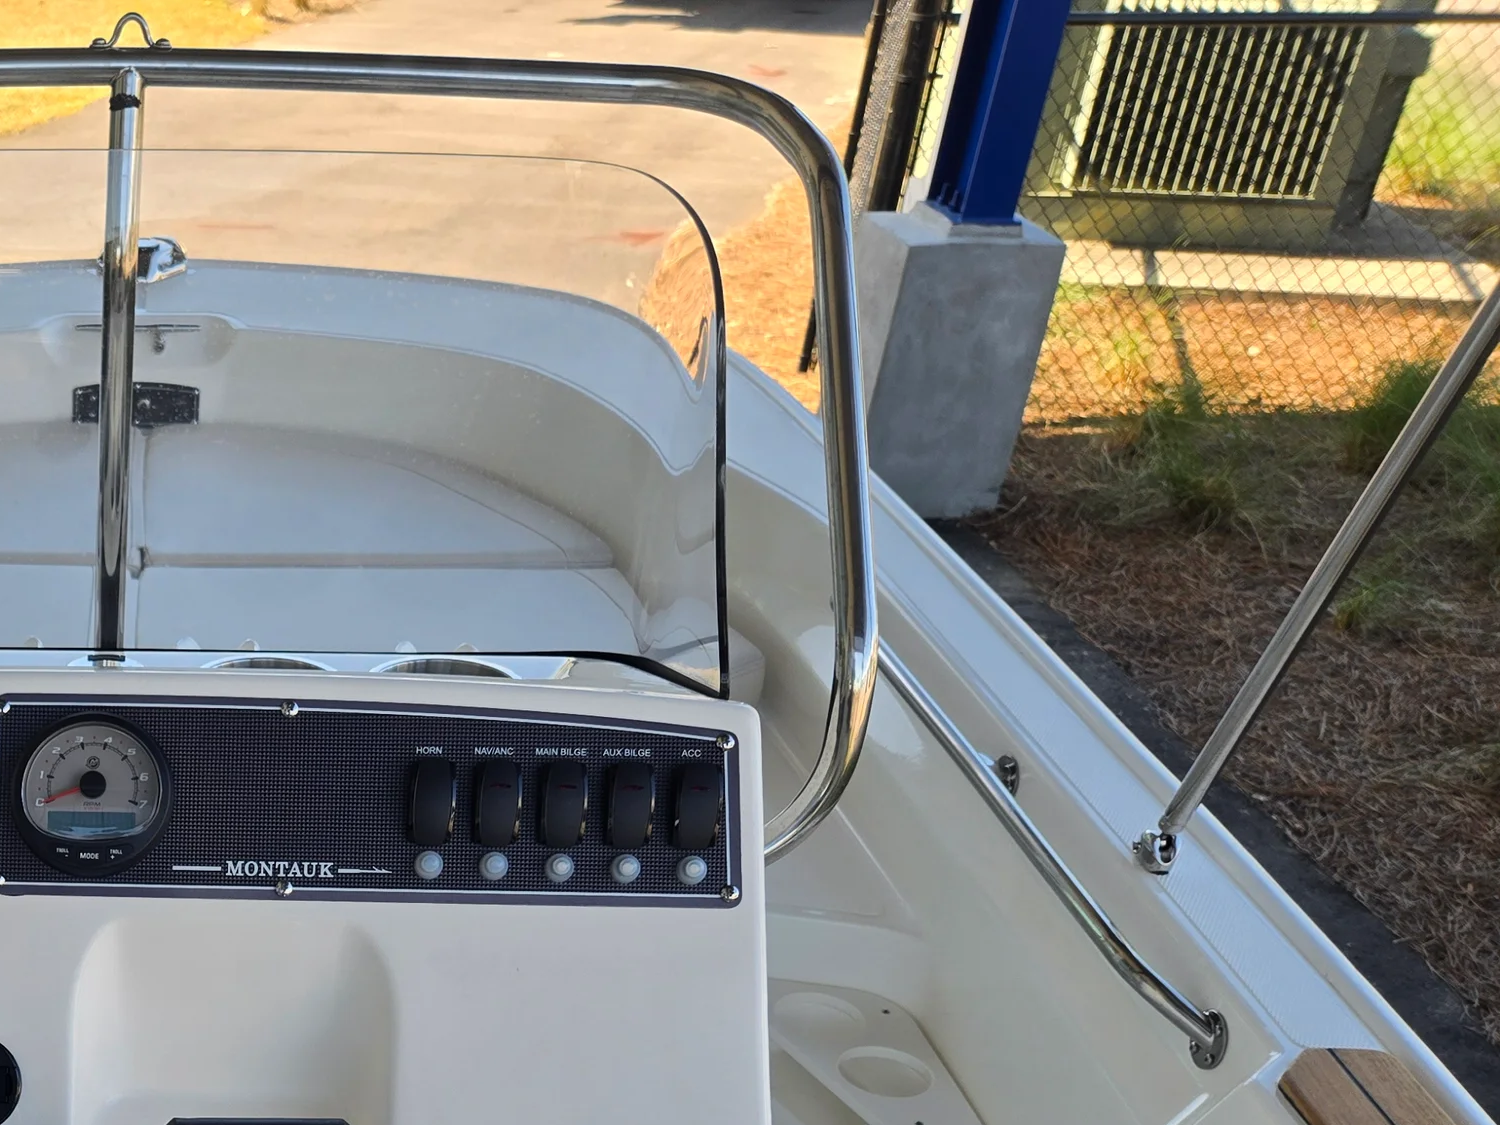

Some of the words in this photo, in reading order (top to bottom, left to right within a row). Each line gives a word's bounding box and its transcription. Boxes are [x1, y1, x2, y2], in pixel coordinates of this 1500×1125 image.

[416, 746, 442, 755] HORN
[474, 746, 514, 756] NAV/ANC
[535, 748, 558, 756] MAIN
[560, 748, 587, 757] BILGE
[603, 748, 622, 757] AUX
[624, 749, 651, 758] BILGE
[681, 749, 701, 758] ACC
[40, 770, 44, 779] 1
[140, 773, 149, 781] 6
[138, 800, 148, 809] 7
[225, 860, 334, 878] MONTAUK
